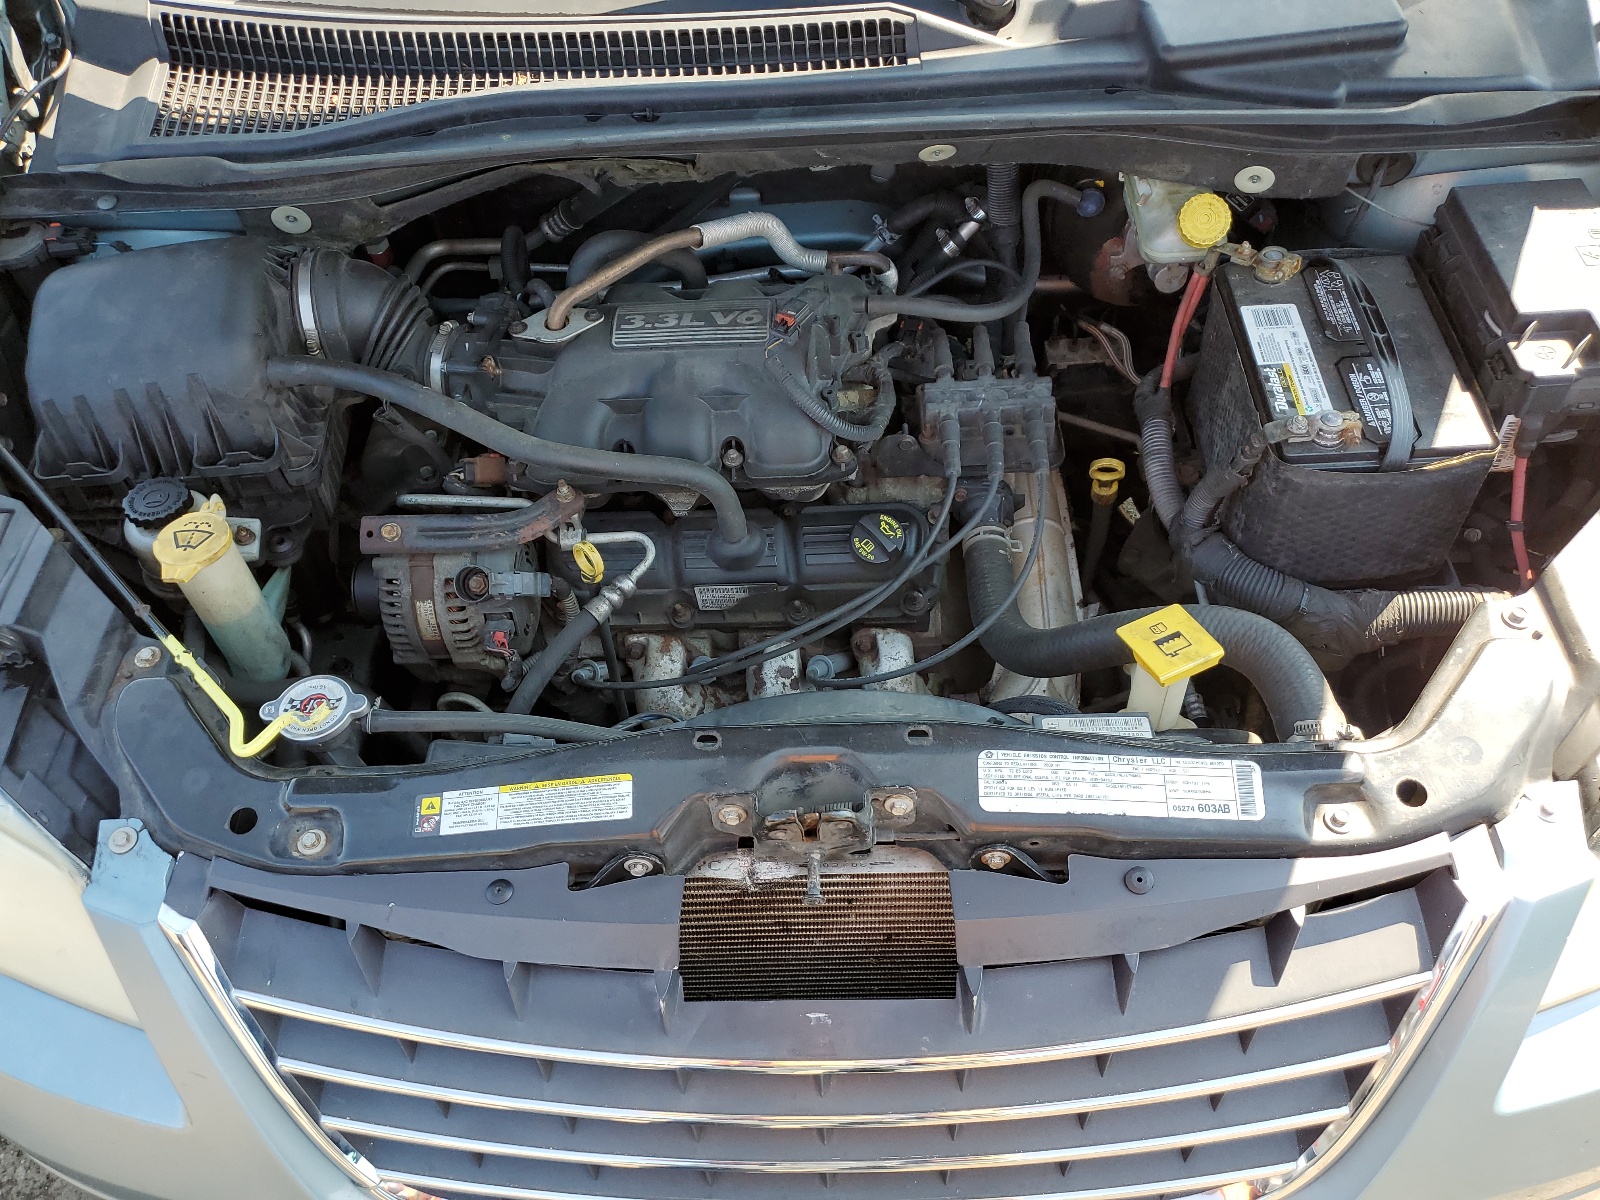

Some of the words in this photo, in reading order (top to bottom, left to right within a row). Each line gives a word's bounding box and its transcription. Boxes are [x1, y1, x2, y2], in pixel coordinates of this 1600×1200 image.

[620, 313, 705, 329] 3.3L
[710, 309, 765, 325] V6
[1264, 366, 1289, 413] Duralast
[880, 514, 899, 529] ENGINE
[895, 528, 903, 538] OIL
[1112, 755, 1149, 766] Chrysler
[1152, 756, 1166, 766] LLC
[1172, 804, 1195, 812] 05274
[1197, 803, 1231, 814] 603AB
